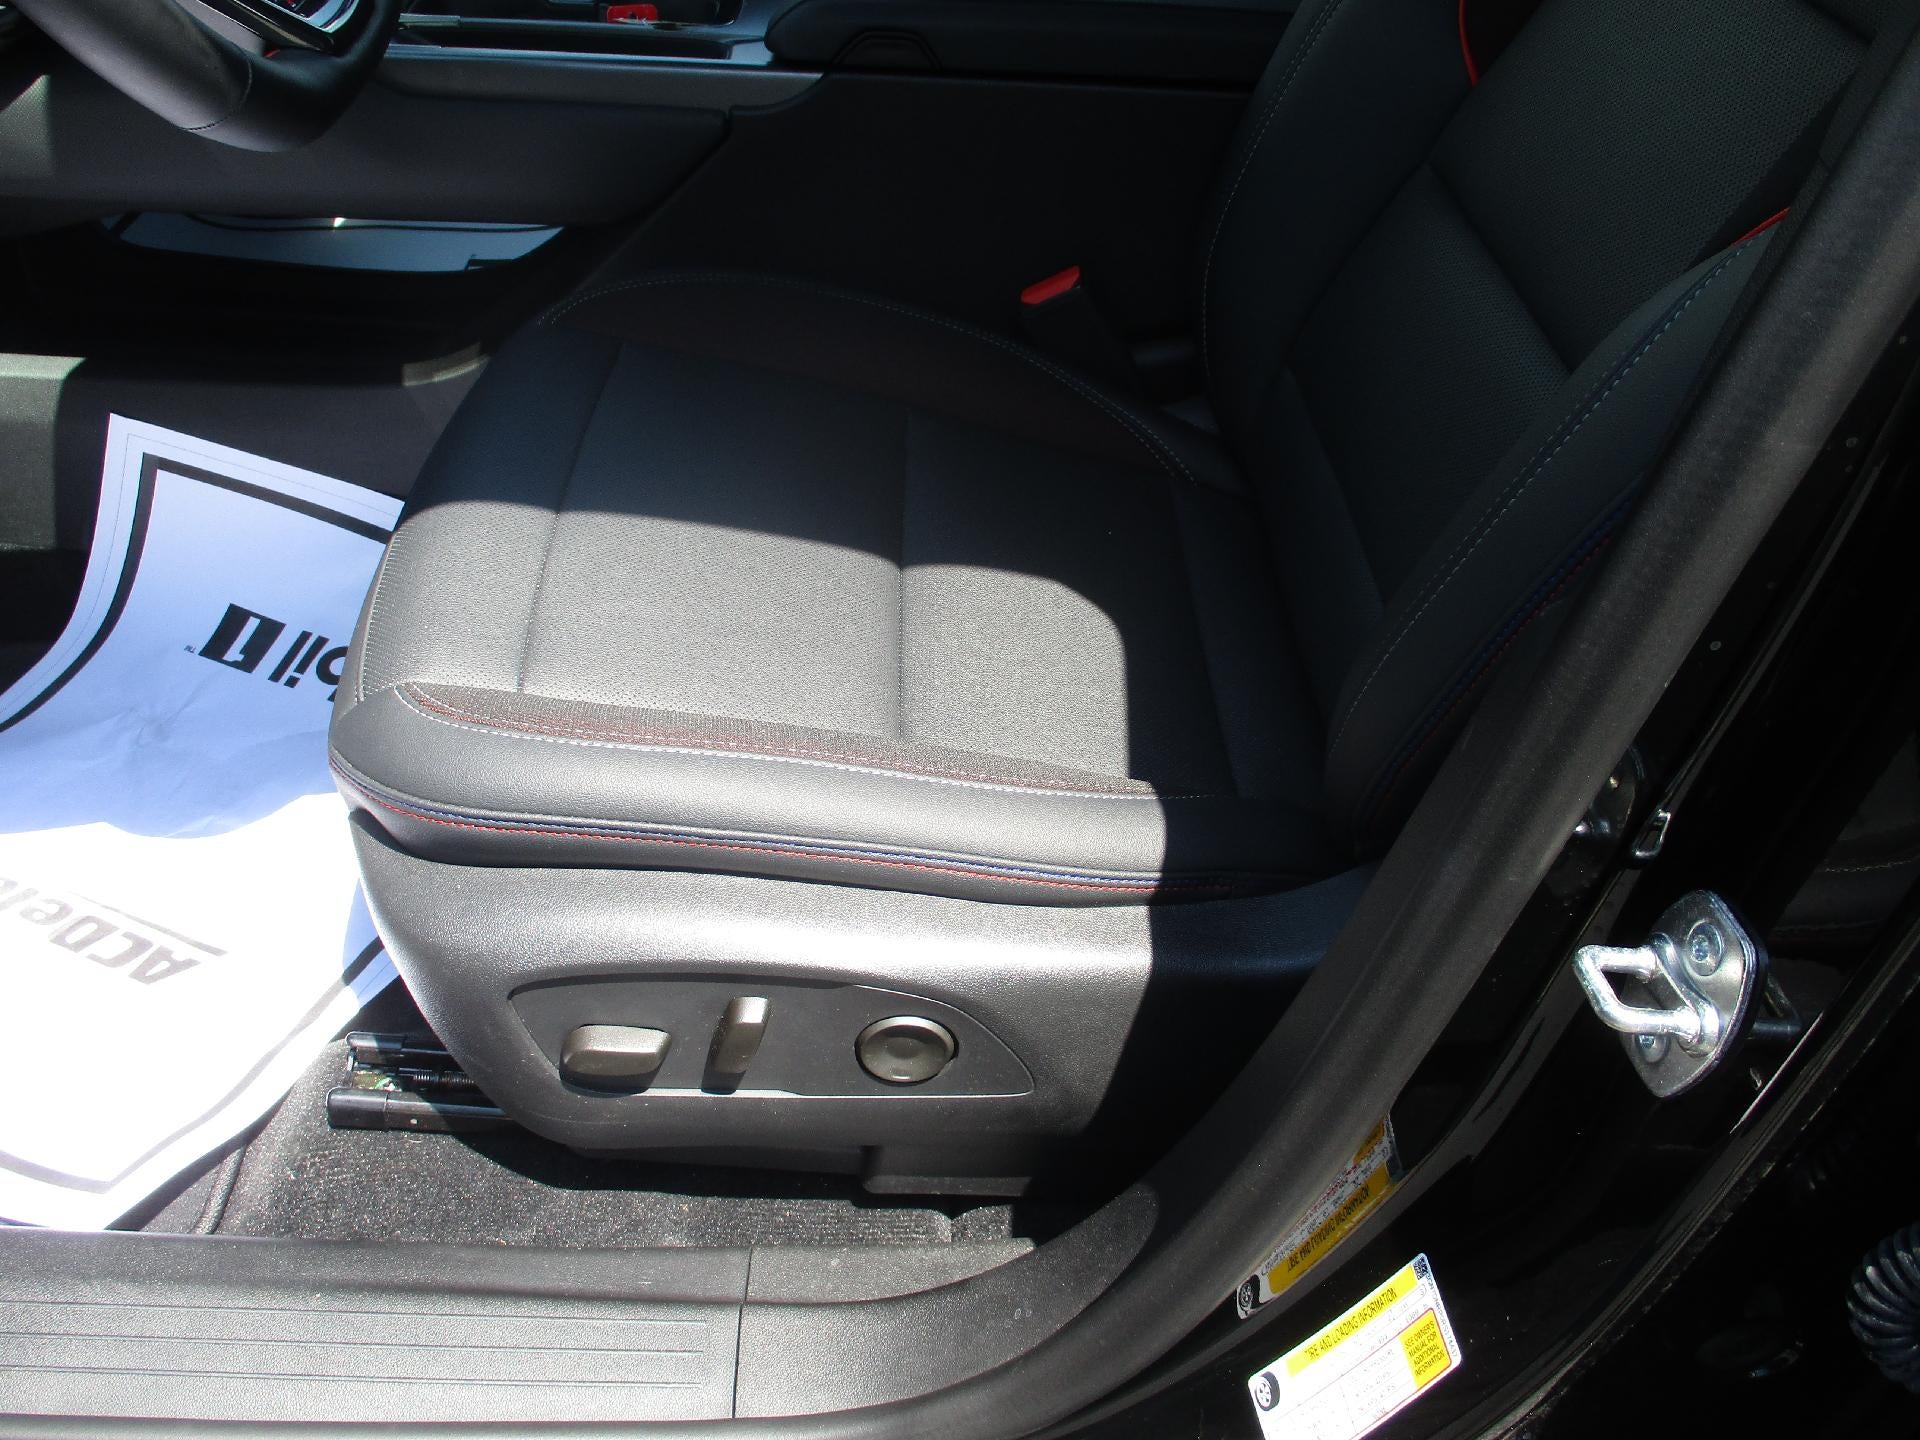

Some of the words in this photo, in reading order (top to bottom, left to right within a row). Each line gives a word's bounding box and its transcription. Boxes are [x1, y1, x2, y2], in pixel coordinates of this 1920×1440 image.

[0, 877, 201, 985] ACDel
[1304, 1342, 1320, 1361] TIRE
[1319, 1333, 1333, 1355] AND
[1332, 1317, 1359, 1346] LOADING
[1358, 1287, 1397, 1328] INFORMATION
[1404, 1335, 1415, 1350] SEE
[1408, 1340, 1428, 1358] MANUAL
[1427, 1331, 1438, 1345] FOR
[1413, 1344, 1440, 1366] ADDITIONAL
[1414, 1349, 1446, 1377] INFORMATION
